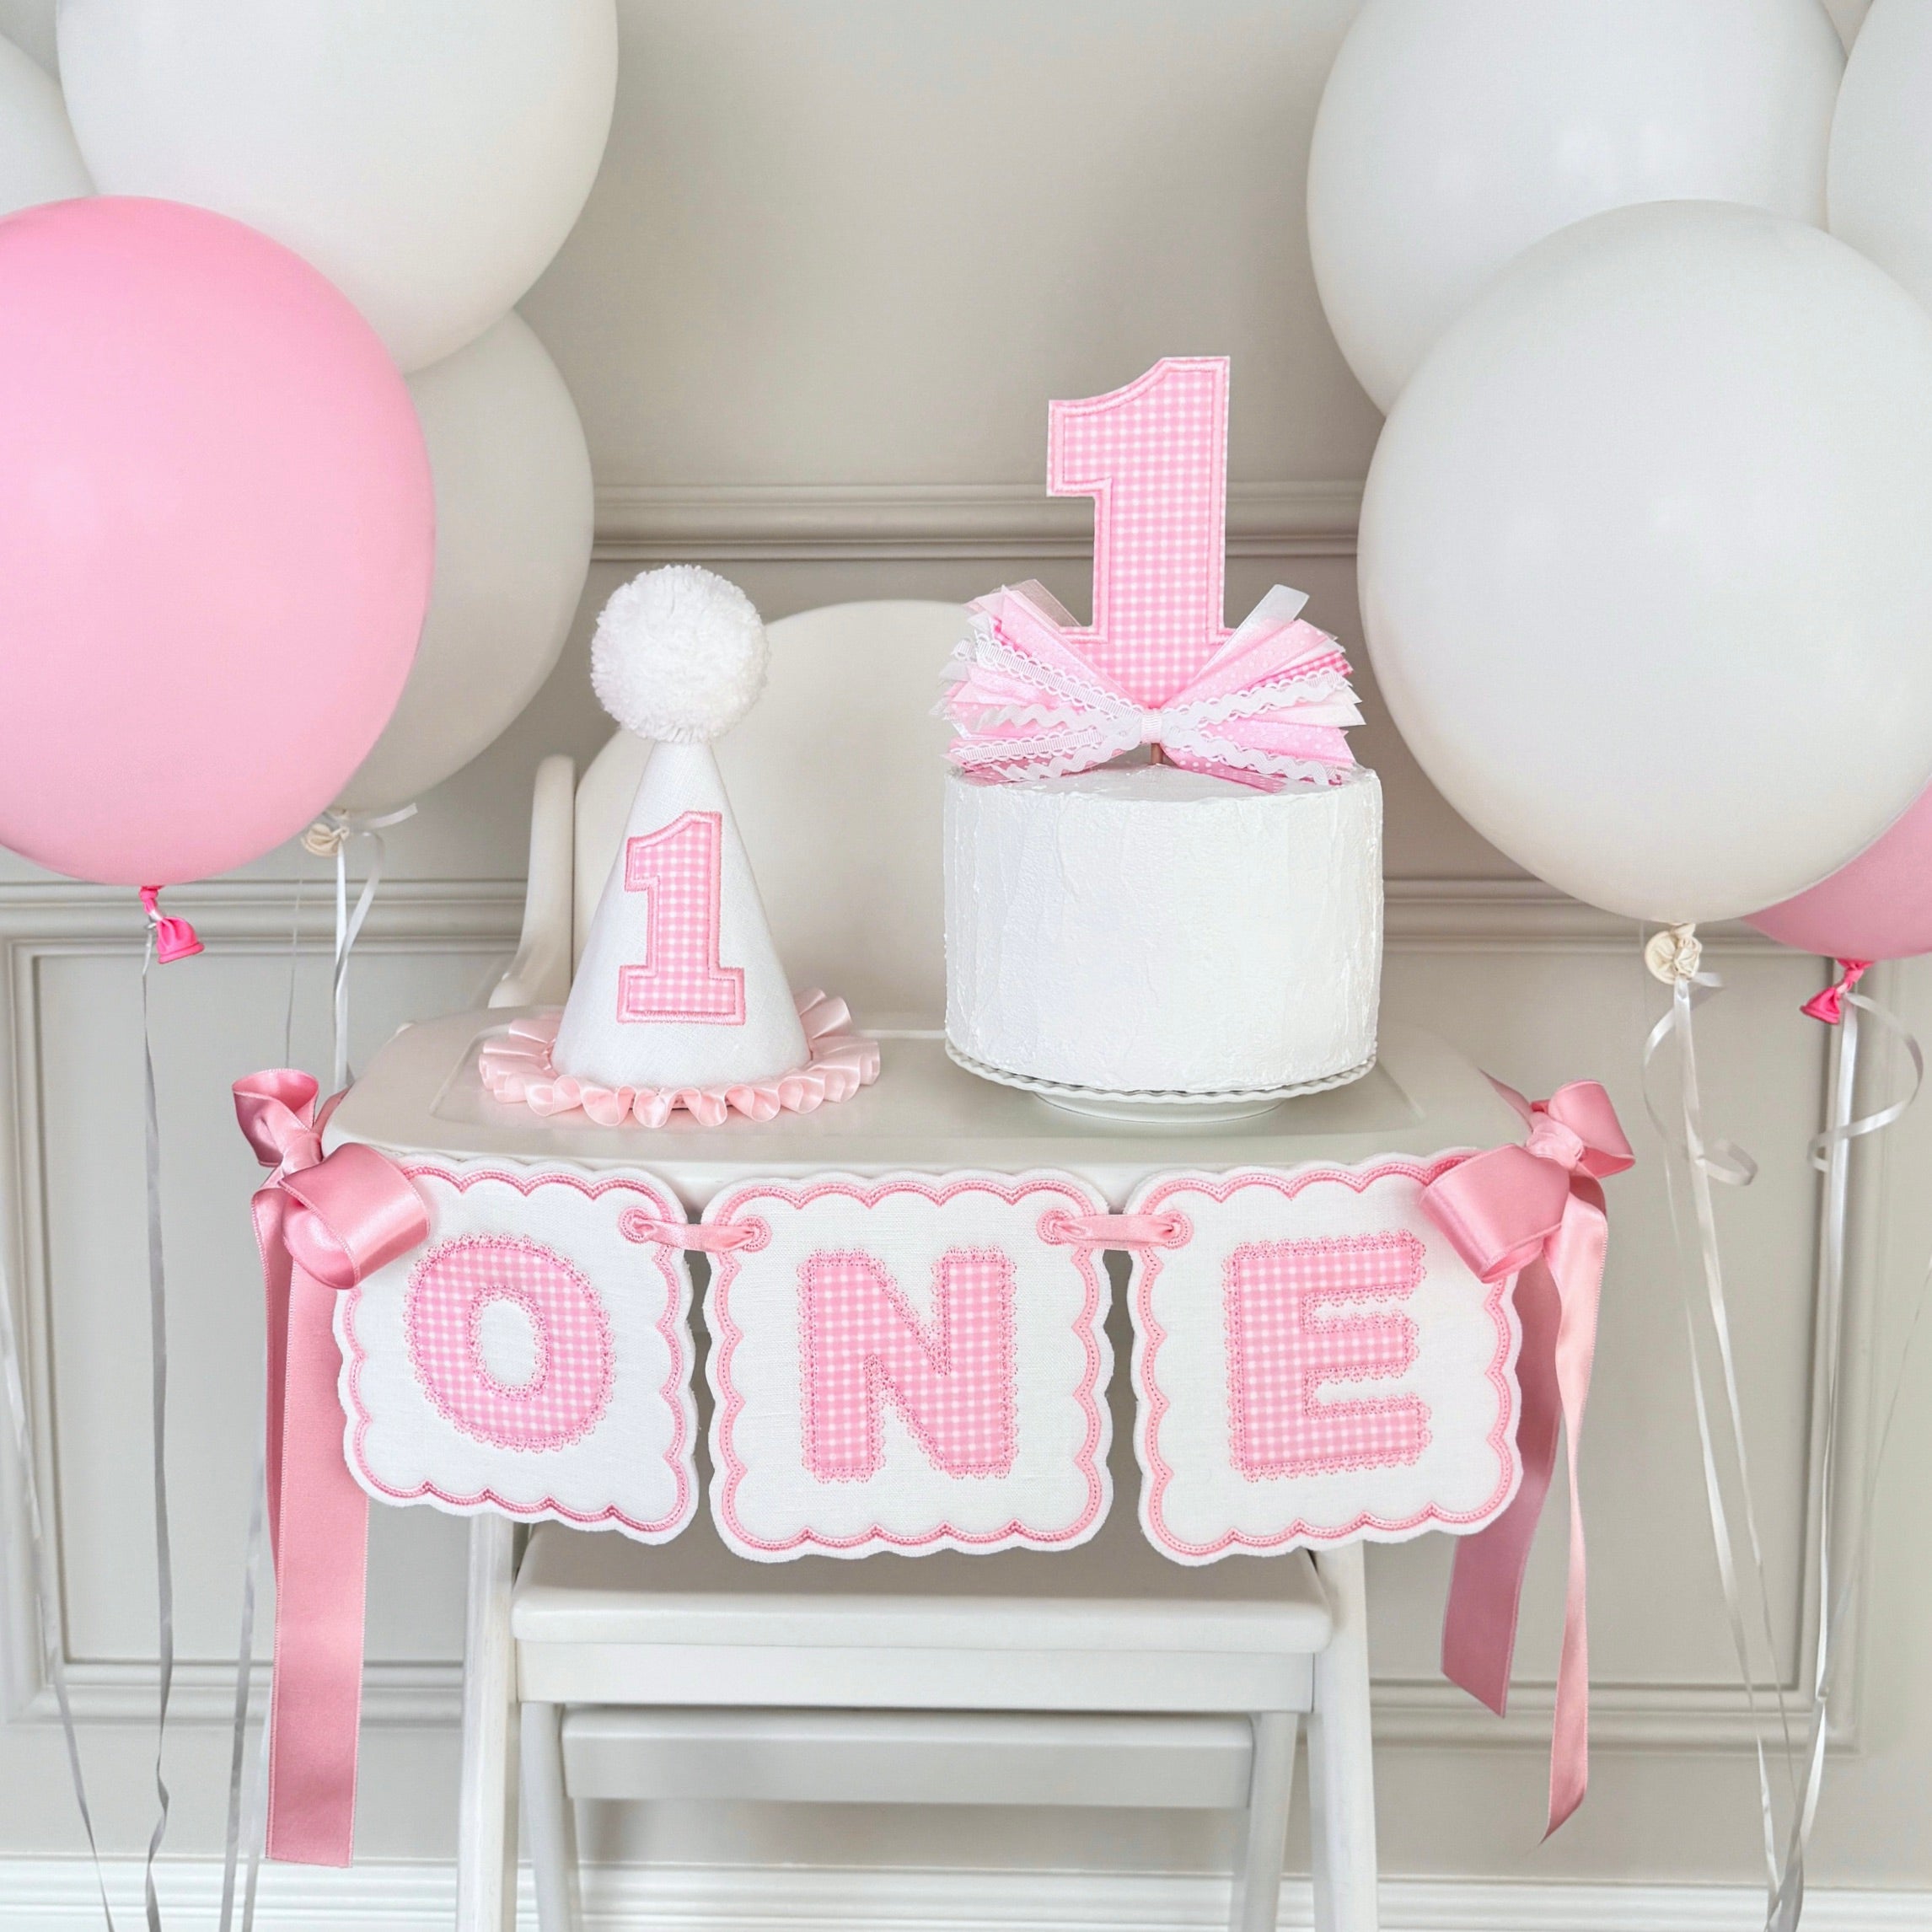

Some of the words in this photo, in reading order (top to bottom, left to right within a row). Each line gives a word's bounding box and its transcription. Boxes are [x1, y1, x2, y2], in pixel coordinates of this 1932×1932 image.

[1046, 356, 1230, 708] 1
[617, 810, 746, 1025] 1
[404, 1229, 1431, 1484] ONE
